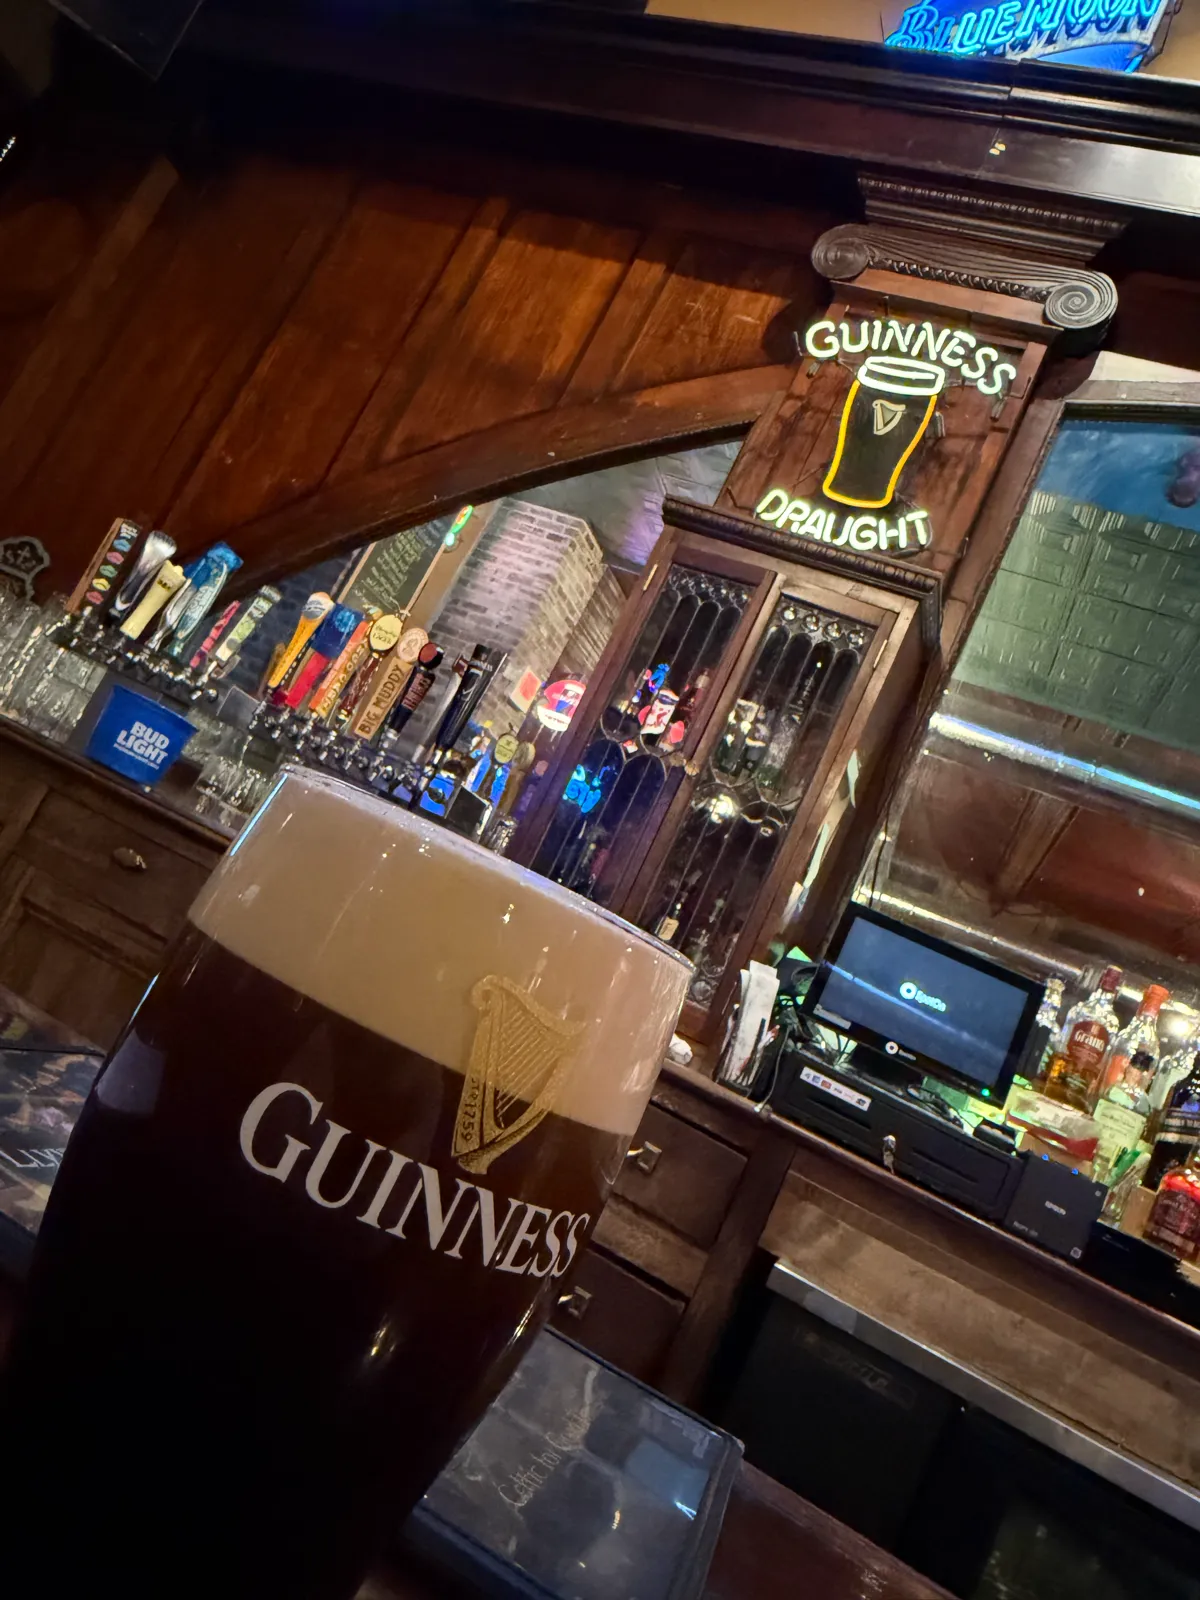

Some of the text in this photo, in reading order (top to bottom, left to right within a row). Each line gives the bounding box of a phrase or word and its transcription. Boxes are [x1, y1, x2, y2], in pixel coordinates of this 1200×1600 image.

[805, 321, 1017, 396] GUINNESS
[755, 488, 930, 551] DRAUGHT
[357, 710, 375, 735] BIG
[372, 663, 405, 712] MUDDY
[116, 729, 169, 765] LIGHT
[130, 720, 170, 750] BUD
[461, 1102, 477, 1141] 1759
[238, 1081, 590, 1279] GUINNESS
